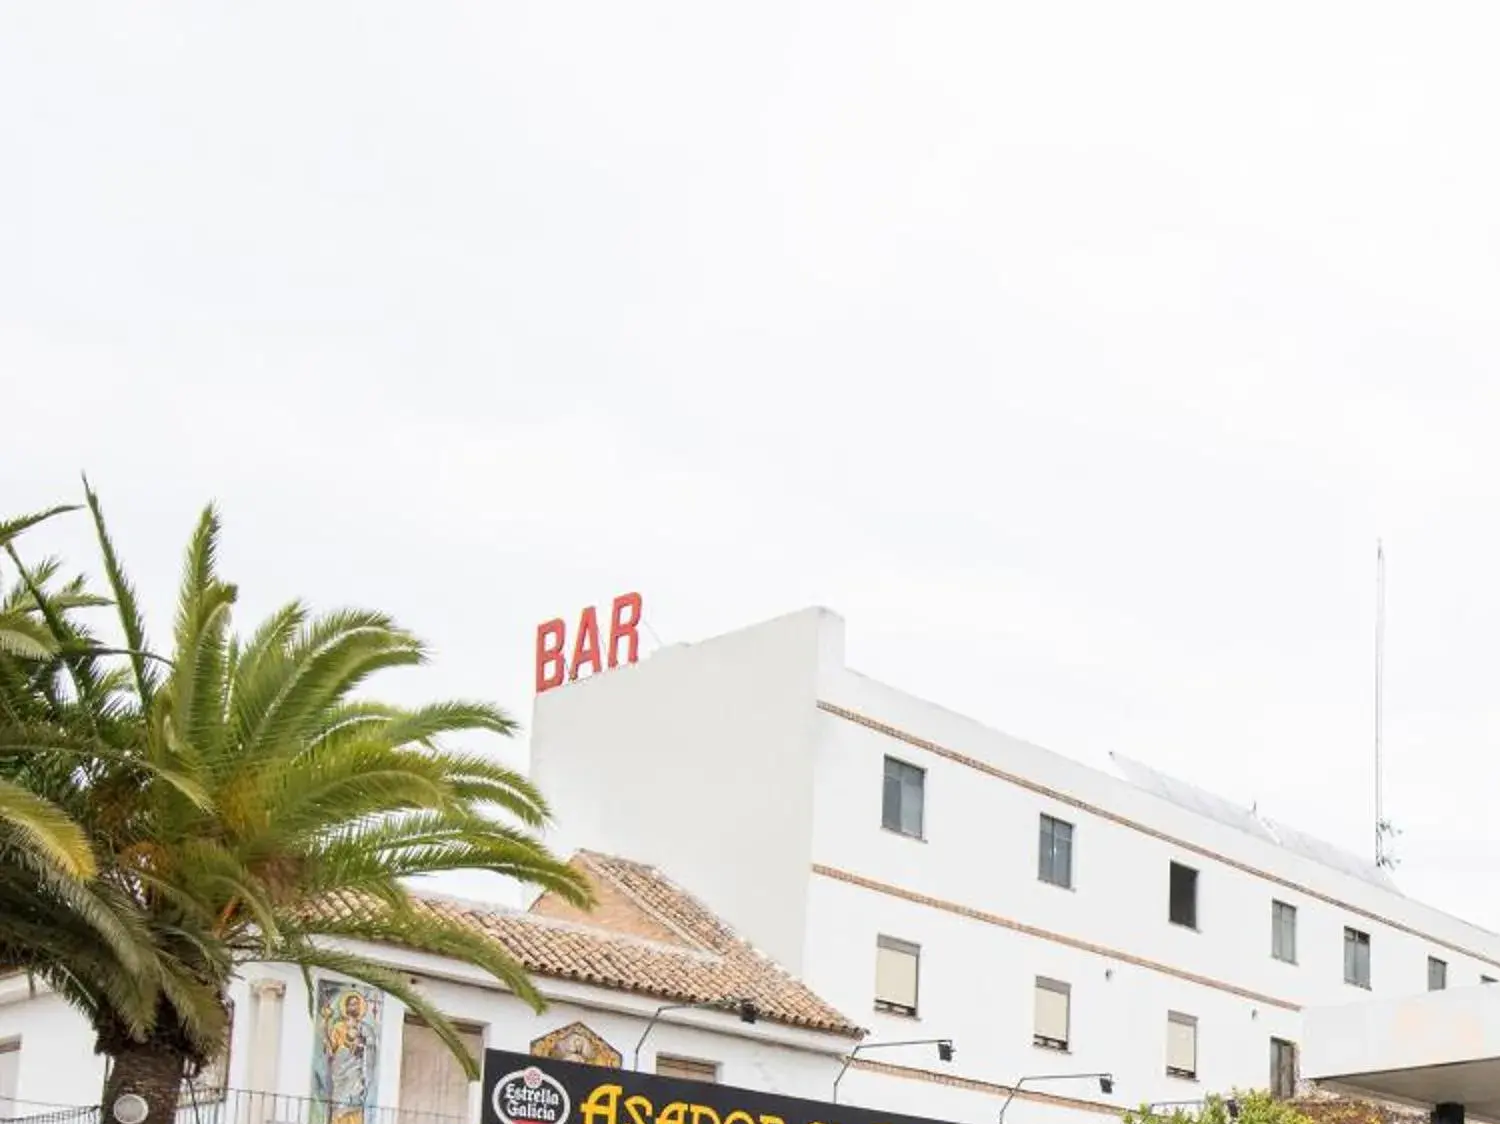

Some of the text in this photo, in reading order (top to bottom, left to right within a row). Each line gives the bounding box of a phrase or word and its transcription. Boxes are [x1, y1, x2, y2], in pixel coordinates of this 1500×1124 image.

[535, 592, 643, 694] BAR
[505, 1083, 559, 1106] Estrella
[507, 1099, 556, 1121] Galicia
